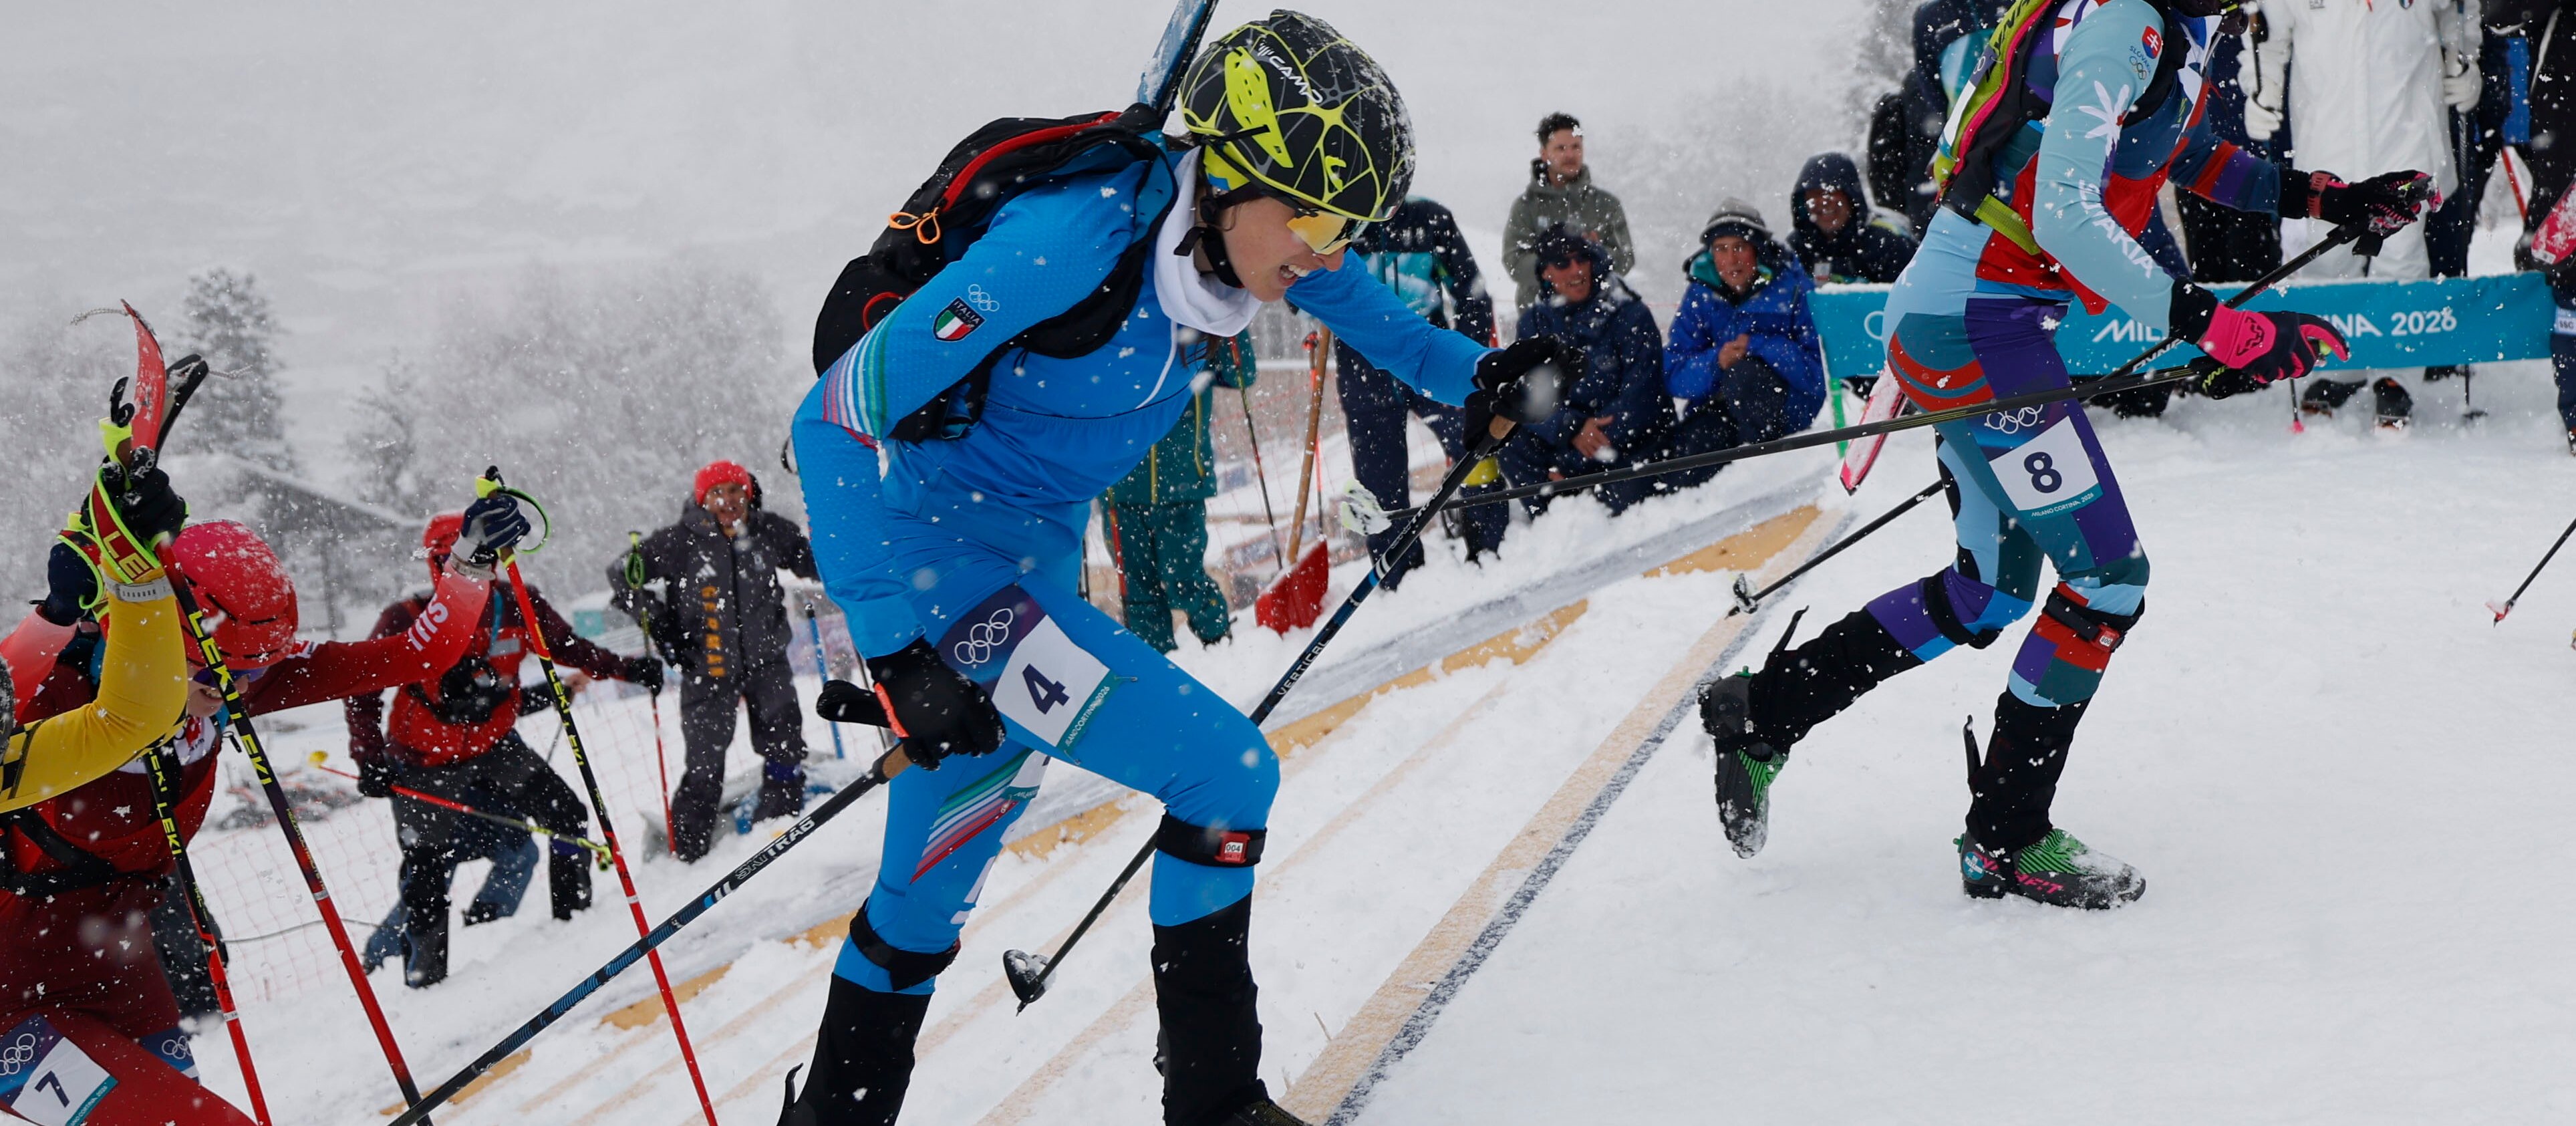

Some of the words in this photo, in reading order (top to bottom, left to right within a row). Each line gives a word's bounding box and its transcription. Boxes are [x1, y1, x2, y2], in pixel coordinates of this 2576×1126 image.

[1270, 55, 1324, 104] CAMP
[954, 300, 980, 325] ITALIA
[2390, 309, 2458, 336] 2026
[2023, 452, 2062, 493] 8
[2053, 500, 2081, 513] CORTINA
[2080, 492, 2094, 503] 2026
[188, 610, 240, 702] LEKI
[1276, 640, 1330, 696] VERTICAL
[1022, 663, 1070, 715] 4
[157, 802, 182, 855] LEKI
[1226, 844, 1241, 852] 004
[34, 1071, 69, 1108] 7
